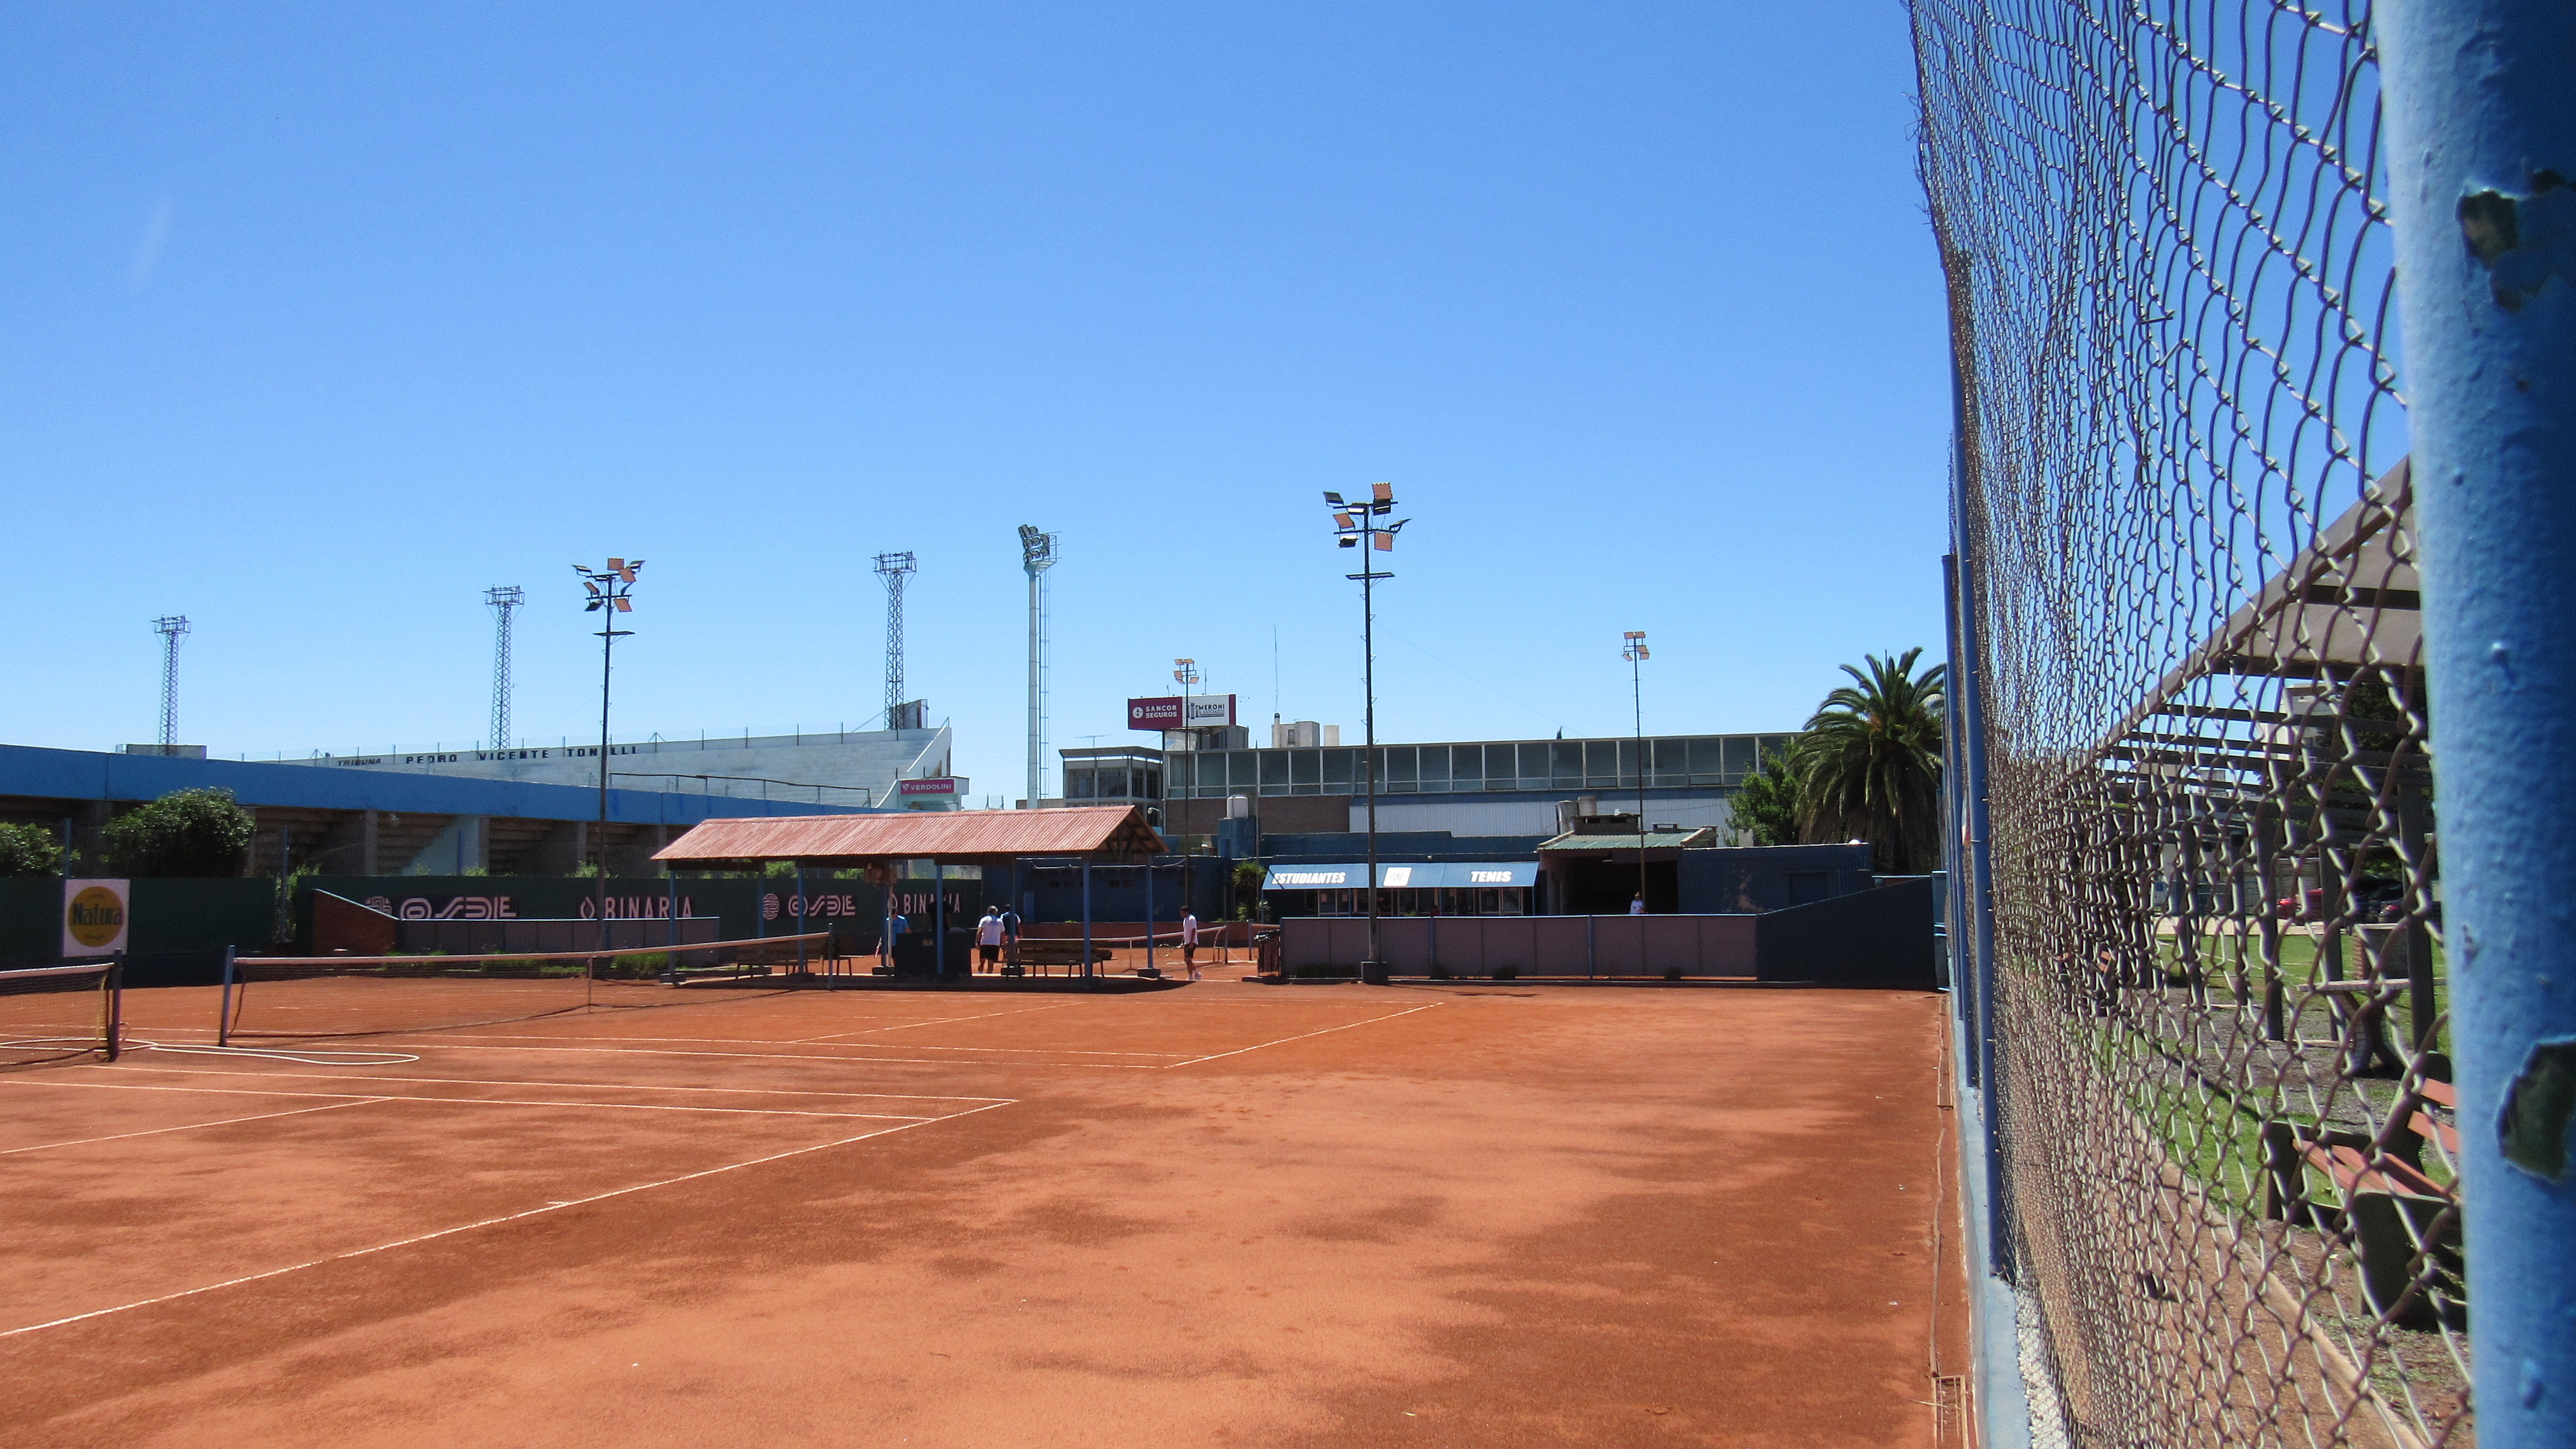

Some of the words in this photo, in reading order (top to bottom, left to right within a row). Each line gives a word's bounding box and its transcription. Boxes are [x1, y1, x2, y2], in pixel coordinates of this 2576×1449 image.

[406, 755, 457, 764] PEDRO
[479, 750, 549, 760] VICENTE
[567, 746, 636, 757] TONLLI
[1272, 872, 1346, 884] ESTUDIANTES
[1470, 871, 1512, 882] TENIS
[605, 897, 692, 918] BINARIA
[904, 894, 960, 914] BINAIA
